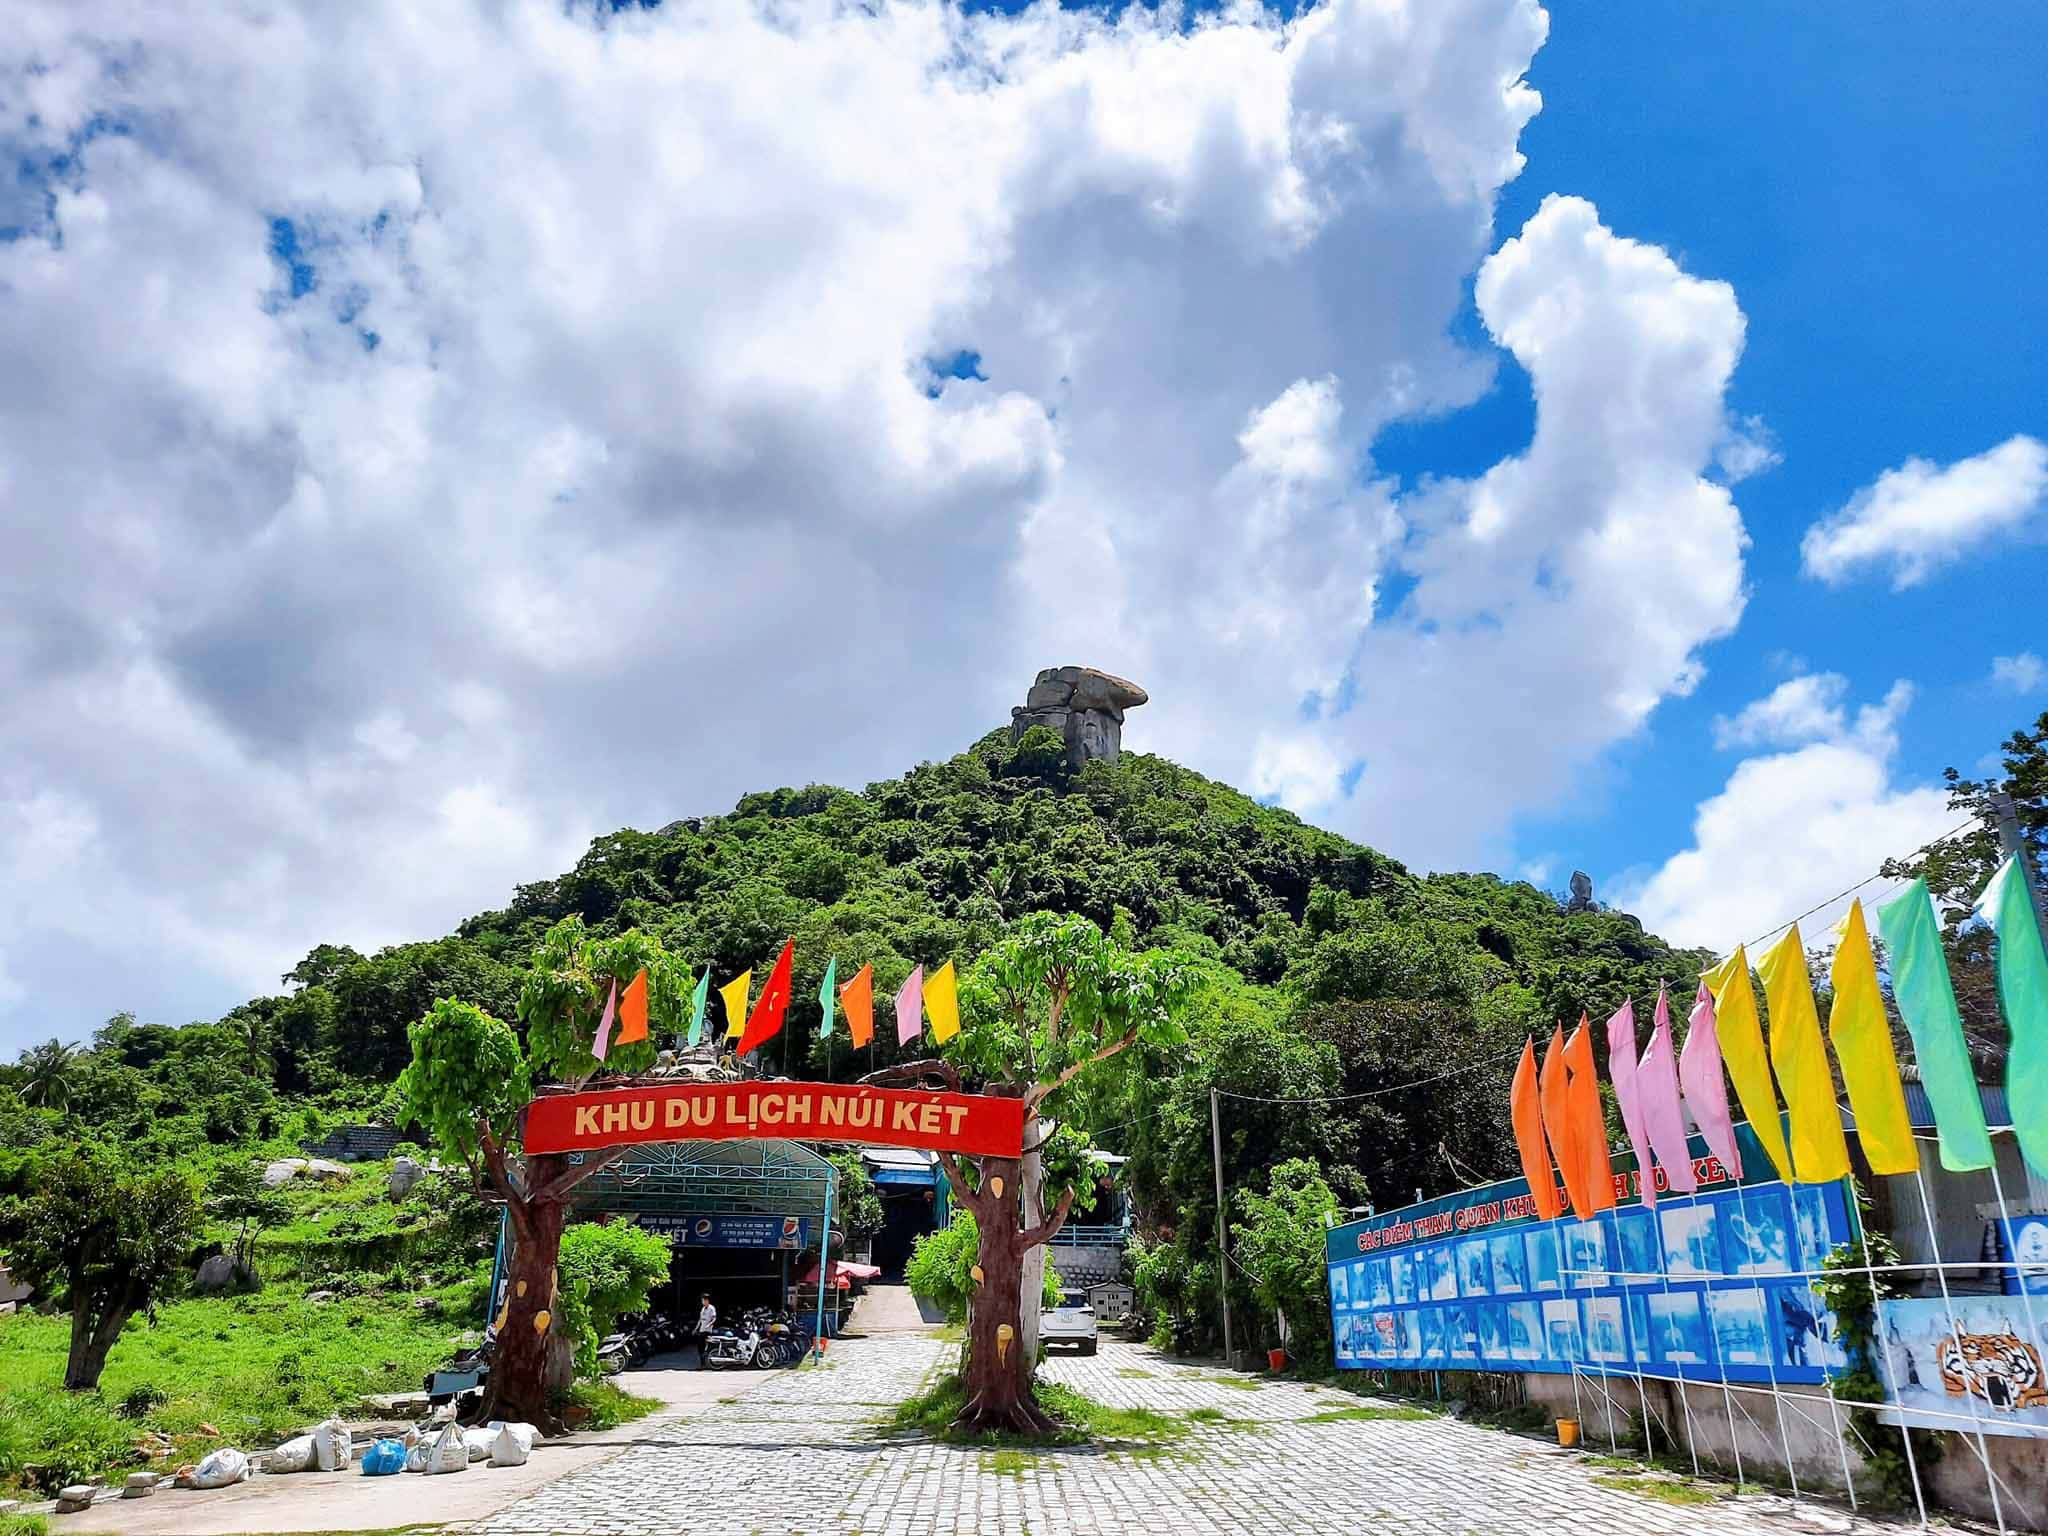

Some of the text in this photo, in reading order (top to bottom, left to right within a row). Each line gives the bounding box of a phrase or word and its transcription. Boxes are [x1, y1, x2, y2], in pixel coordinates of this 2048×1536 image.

[574, 1090, 969, 1136] KHU DU LỊCH NÚI KÉT
[1357, 1228, 1382, 1251] CÁC
[1414, 1211, 1453, 1239] THAM
[1455, 1201, 1501, 1229] QUAN
[1690, 1149, 1743, 1186] KÉ
